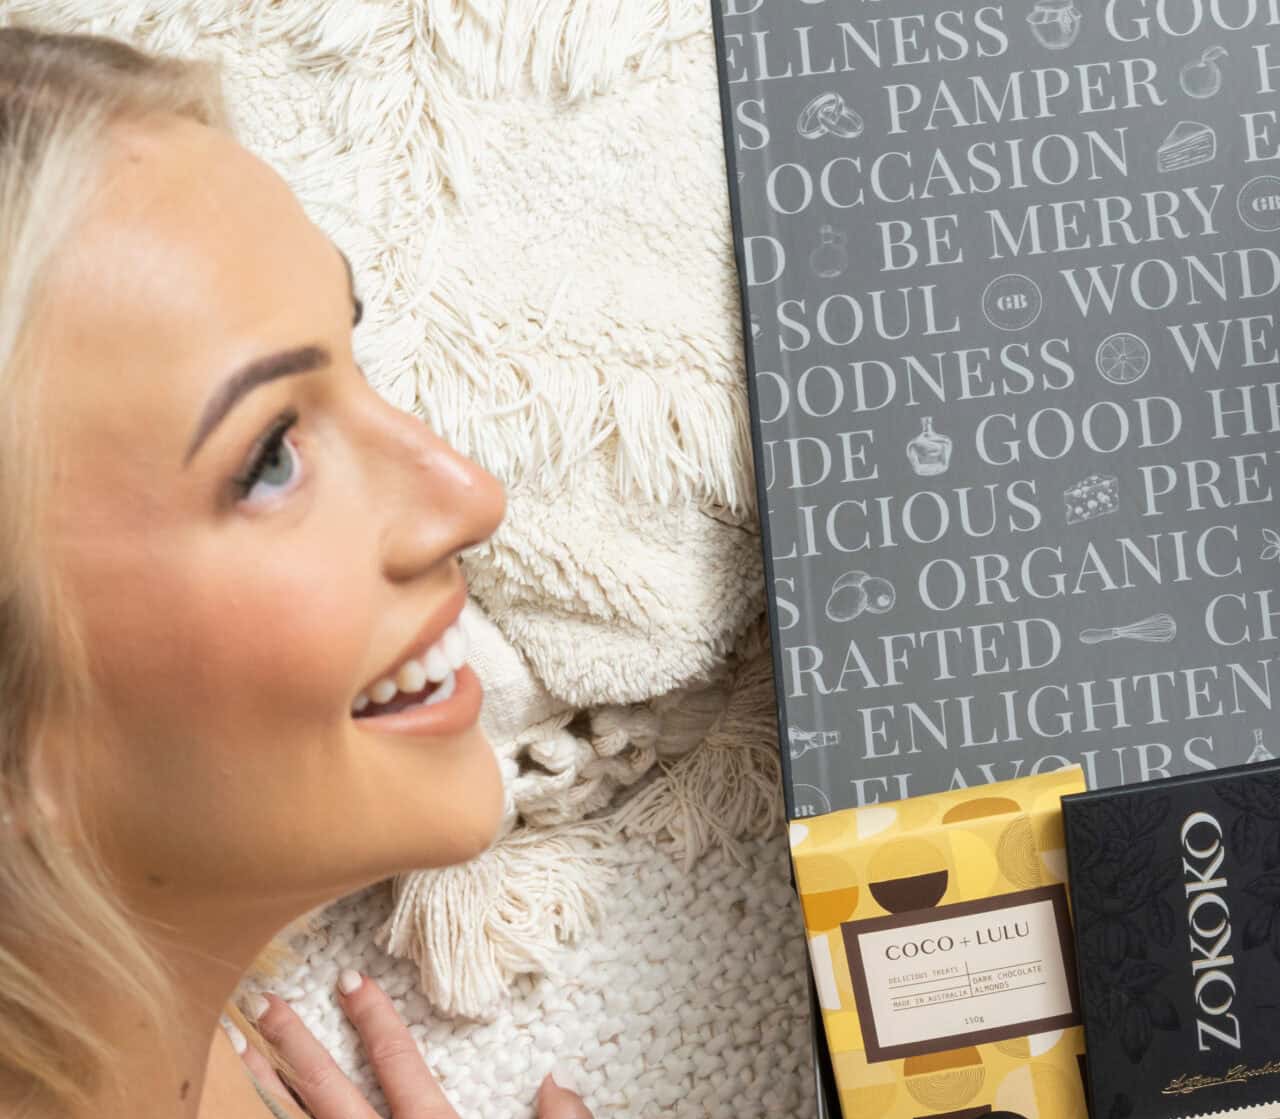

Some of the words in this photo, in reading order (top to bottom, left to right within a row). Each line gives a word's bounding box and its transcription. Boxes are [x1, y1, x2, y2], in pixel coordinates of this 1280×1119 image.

[736, 98, 771, 151] S
[882, 58, 1168, 135] PAMPER
[765, 127, 1130, 215] OCCASION
[876, 214, 964, 272] BE
[984, 184, 1225, 260] MERRY
[776, 284, 961, 352] SOUL
[975, 396, 1183, 466] GOOD
[919, 515, 1242, 612] ORGANIC
[785, 617, 1062, 698] RAFTED
[885, 936, 954, 961] COCO
[976, 921, 1031, 946] LULU
[1180, 811, 1241, 1051] ZOKOKO
[888, 971, 929, 985] DELICIOUS
[932, 966, 960, 977] TREATS
[928, 989, 968, 1003] AUSTRALIA
[972, 973, 994, 985] DARK
[997, 965, 1043, 980] CHOCOLATE
[974, 981, 1010, 994] ALMONDS
